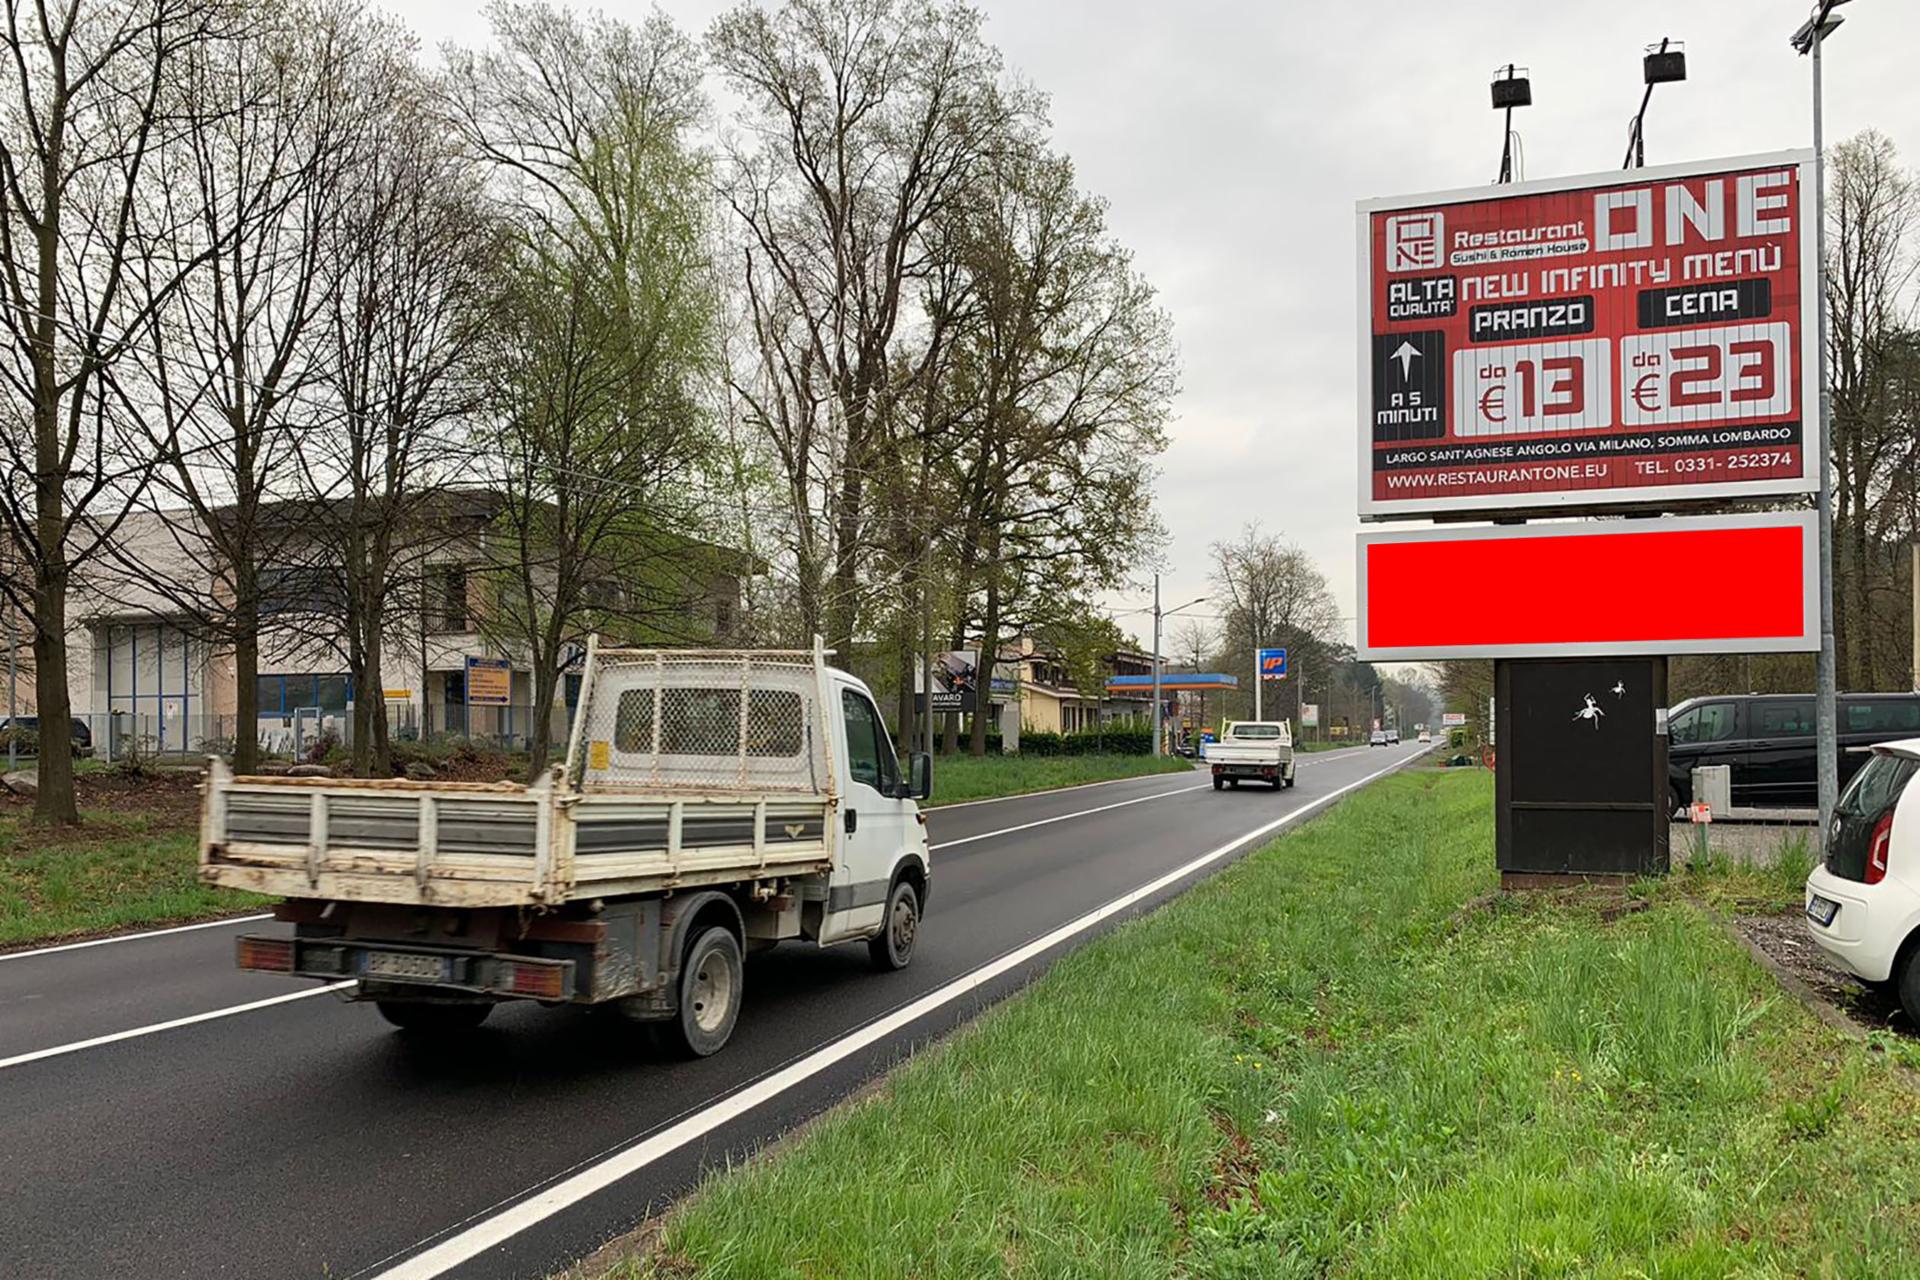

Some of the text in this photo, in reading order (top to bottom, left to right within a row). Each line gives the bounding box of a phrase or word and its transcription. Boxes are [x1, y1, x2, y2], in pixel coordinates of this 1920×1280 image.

[1594, 171, 1791, 252] ONE
[1454, 220, 1585, 249] Restaurant
[1453, 251, 1487, 264] Sushi
[1490, 250, 1497, 260] &
[1547, 241, 1587, 254] House
[1390, 278, 1454, 302] ALTA
[1666, 289, 1738, 317] CENA
[1475, 303, 1585, 333] PRANZO
[1632, 352, 1661, 367] da
[1480, 364, 1506, 379] da
[1391, 391, 1421, 407] A 5
[1377, 407, 1438, 425] MINUTI
[1386, 428, 1792, 464] LARGO SANT'AGNESE ANGOLO VIA MILANO, SOMMA LOMBARDO
[1635, 452, 1792, 474] TEL. 0331- 252374
[1387, 463, 1608, 488] WWW.RESTAURANTONE.EU
[1263, 658, 1283, 670] IP
